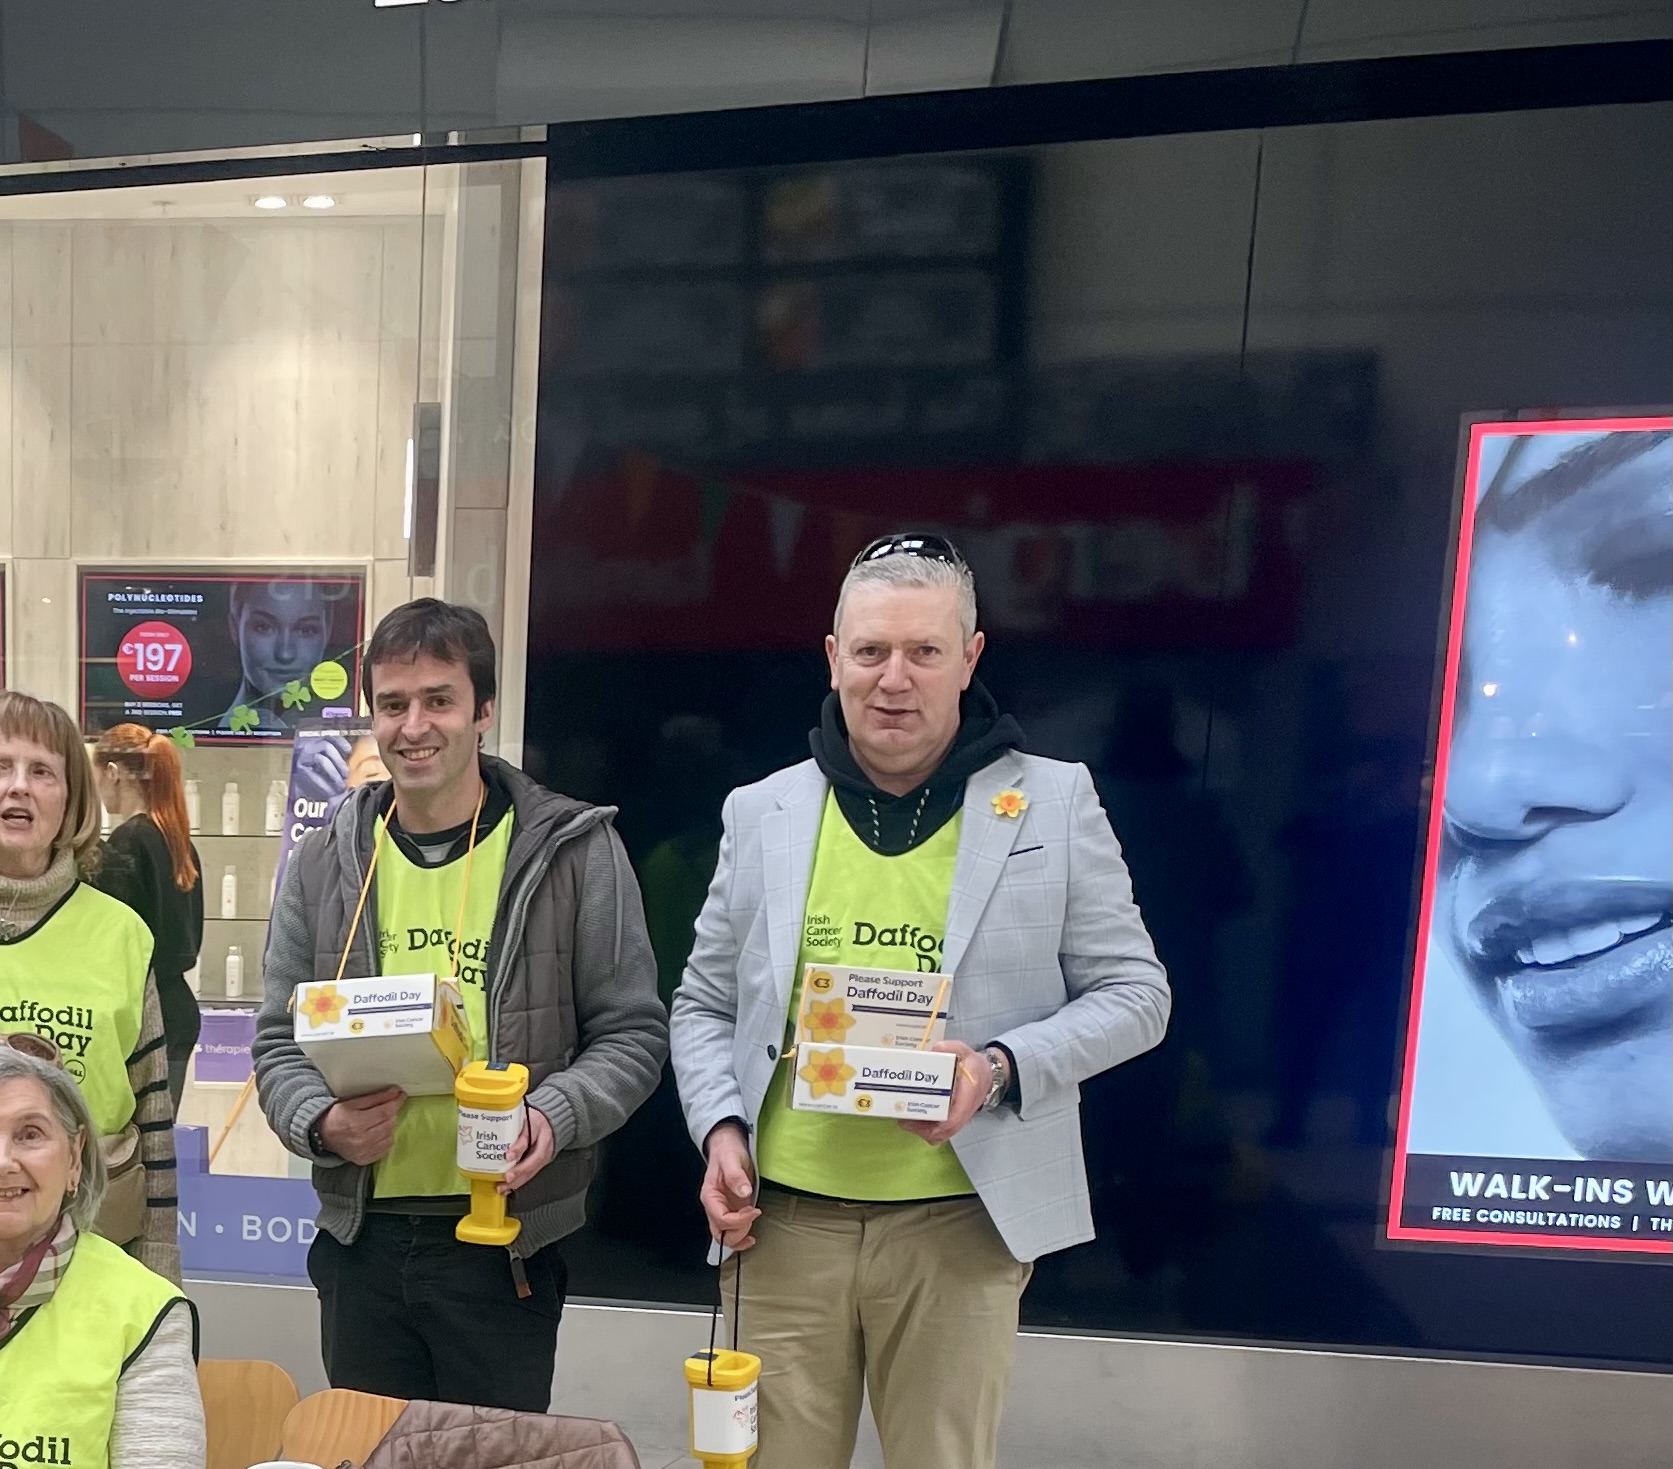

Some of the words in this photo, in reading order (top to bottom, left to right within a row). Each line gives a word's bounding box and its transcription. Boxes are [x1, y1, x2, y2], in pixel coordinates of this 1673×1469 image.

[108, 593, 204, 602] POLYNUCLEOTIDES
[122, 643, 183, 671] €197
[294, 798, 328, 818] Our
[807, 914, 830, 925] Irish
[806, 925, 842, 937] Cancer
[806, 936, 842, 948] Society
[814, 977, 831, 988] €3
[848, 973, 879, 986] Please
[882, 976, 923, 989] Support
[353, 991, 397, 1004] Daffodil
[400, 991, 421, 1002] Day
[847, 986, 902, 1002] Daffodil
[904, 991, 934, 1007] Day
[861, 1067, 912, 1082] Daffodil
[914, 1070, 939, 1087] Day
[476, 1131, 498, 1141] Irish
[476, 1140, 511, 1151] Cancer
[476, 1150, 507, 1161] Societ
[1450, 1171, 1634, 1204] WALK-INS
[1432, 1206, 1471, 1222] FREE
[1476, 1209, 1621, 1230] CONSULTATIONS
